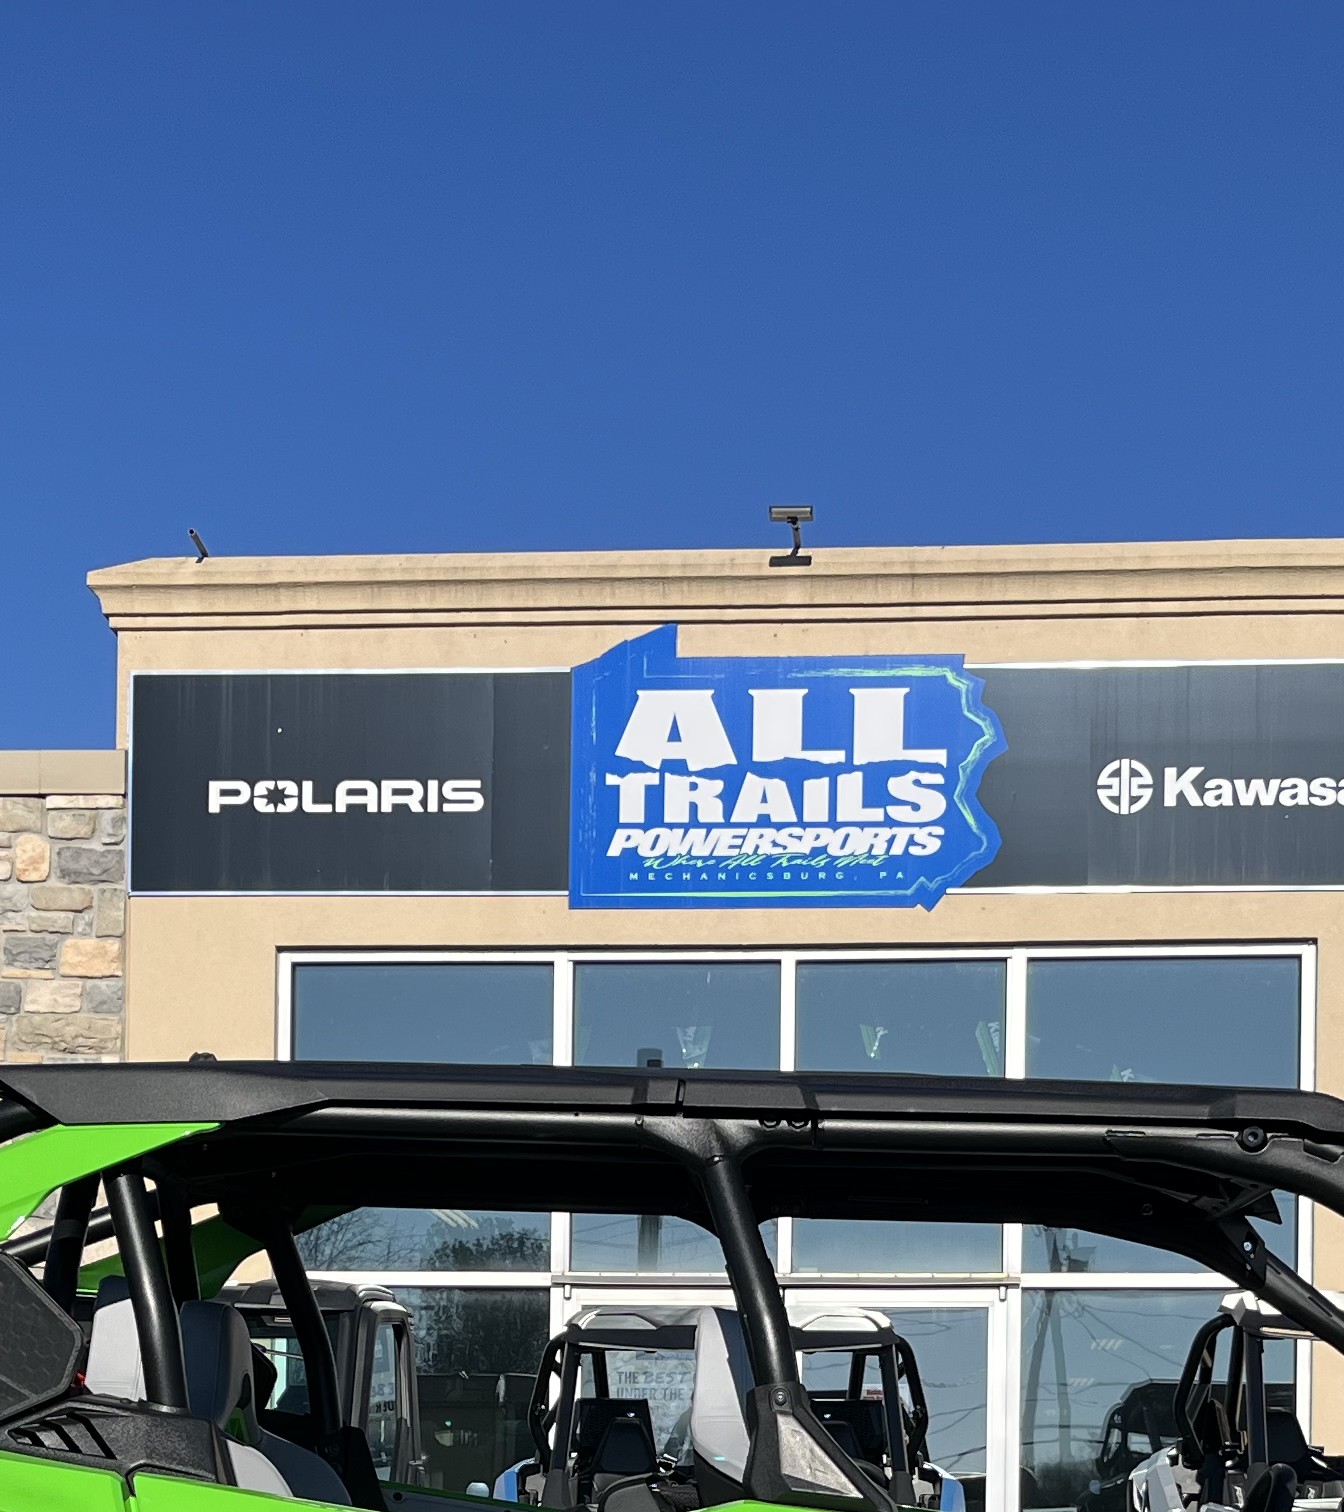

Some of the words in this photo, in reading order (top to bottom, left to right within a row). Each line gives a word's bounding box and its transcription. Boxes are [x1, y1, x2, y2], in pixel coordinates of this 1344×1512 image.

[614, 687, 948, 772] ALL
[207, 778, 486, 815] POLARIS
[605, 770, 948, 824] TRAILS
[605, 826, 946, 858] POWERSPORTS
[643, 853, 716, 869] Where
[719, 853, 764, 869] All
[770, 852, 831, 868] Trails
[879, 871, 904, 880] PA
[617, 1371, 640, 1384] THE
[644, 1371, 692, 1385] BEST
[662, 1387, 685, 1401] THE
